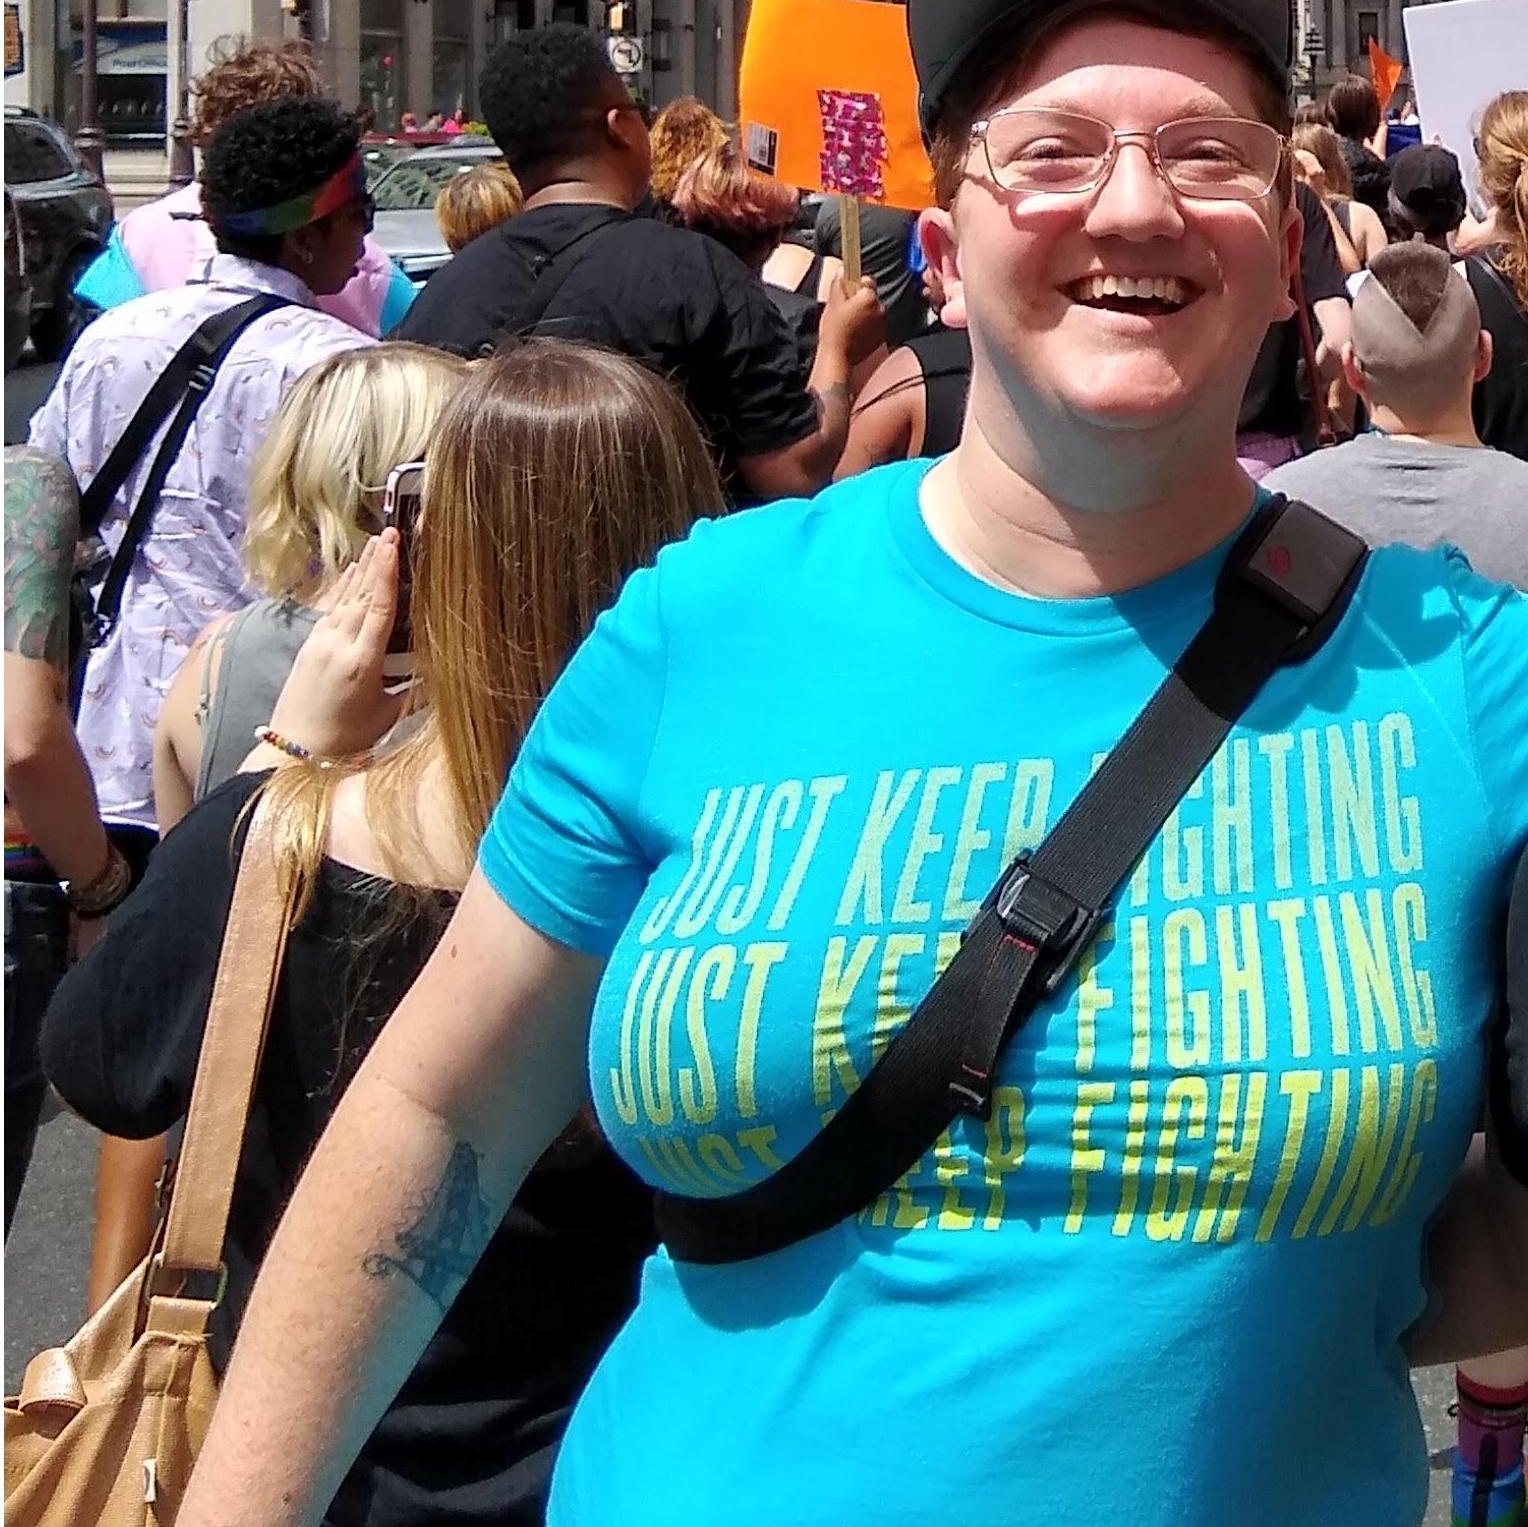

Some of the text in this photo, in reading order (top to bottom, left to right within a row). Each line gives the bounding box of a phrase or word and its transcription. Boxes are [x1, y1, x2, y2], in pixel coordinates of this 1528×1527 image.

[639, 770, 850, 945] JUST
[833, 756, 1057, 928] KEEP
[609, 940, 786, 1127] JUST
[1073, 882, 1440, 1073] FIGHTING
[1063, 1058, 1439, 1244] FIGHTING
